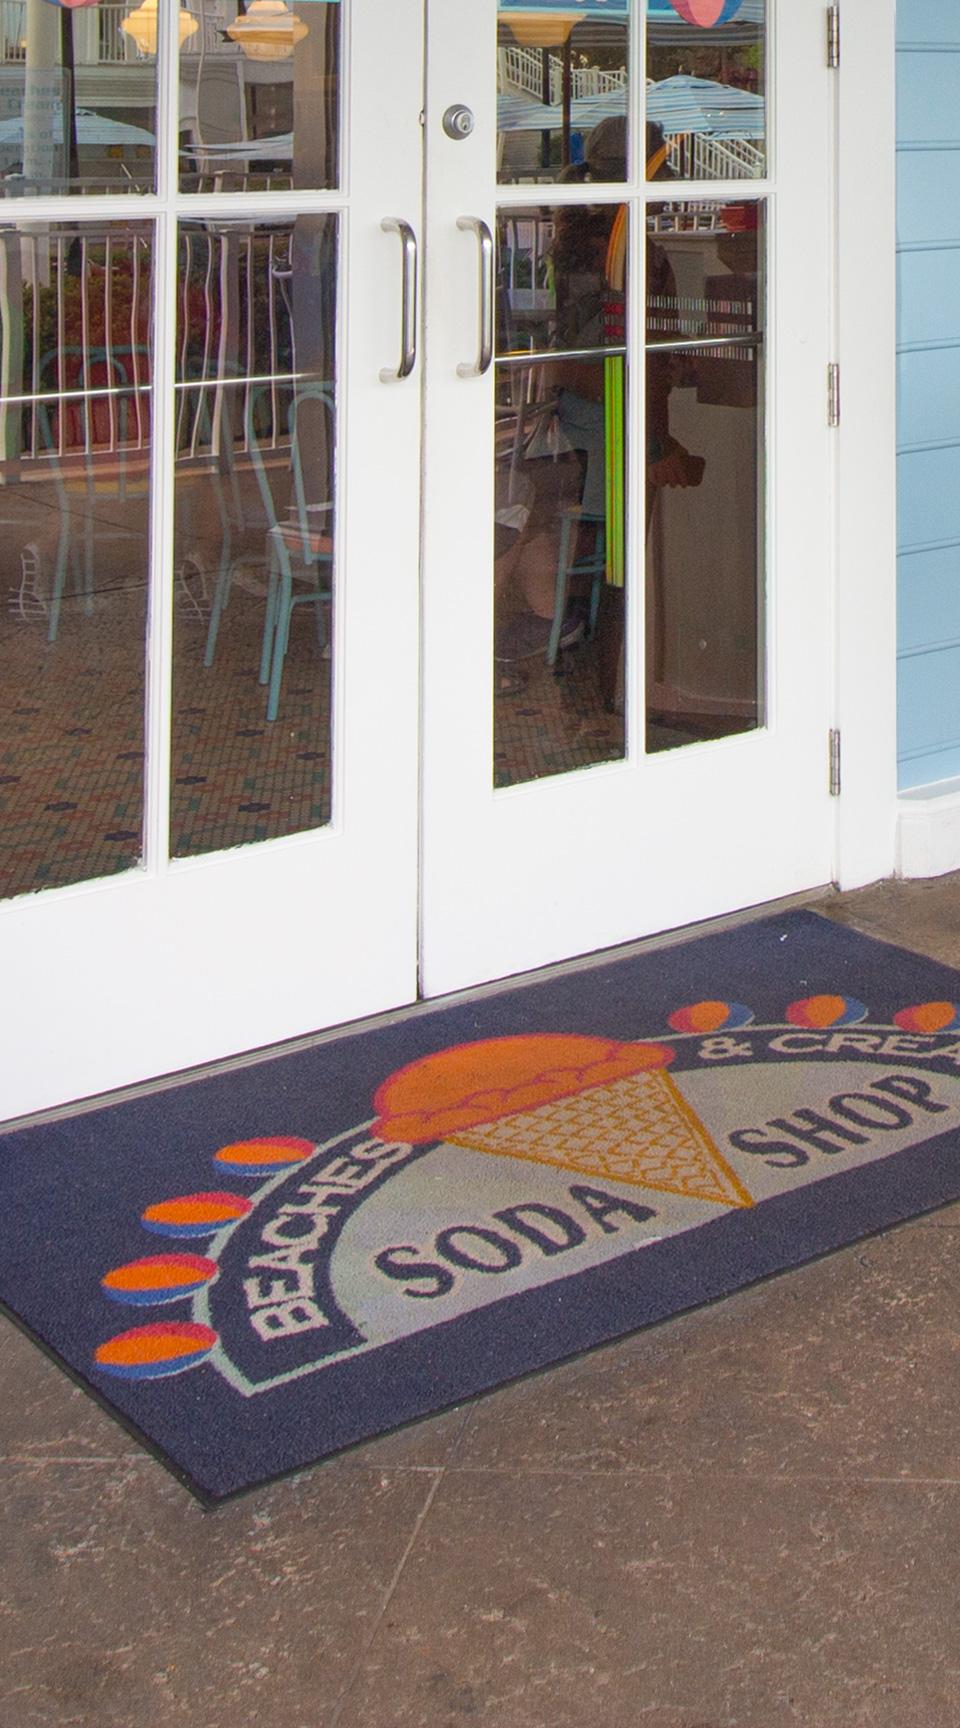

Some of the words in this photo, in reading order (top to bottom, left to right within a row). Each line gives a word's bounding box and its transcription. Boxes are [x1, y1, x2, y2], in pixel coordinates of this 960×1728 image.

[252, 1136, 414, 1342] BEACHES
[698, 1034, 755, 1059] &
[374, 1183, 658, 1299] SODA
[731, 1074, 948, 1171] SHOP
